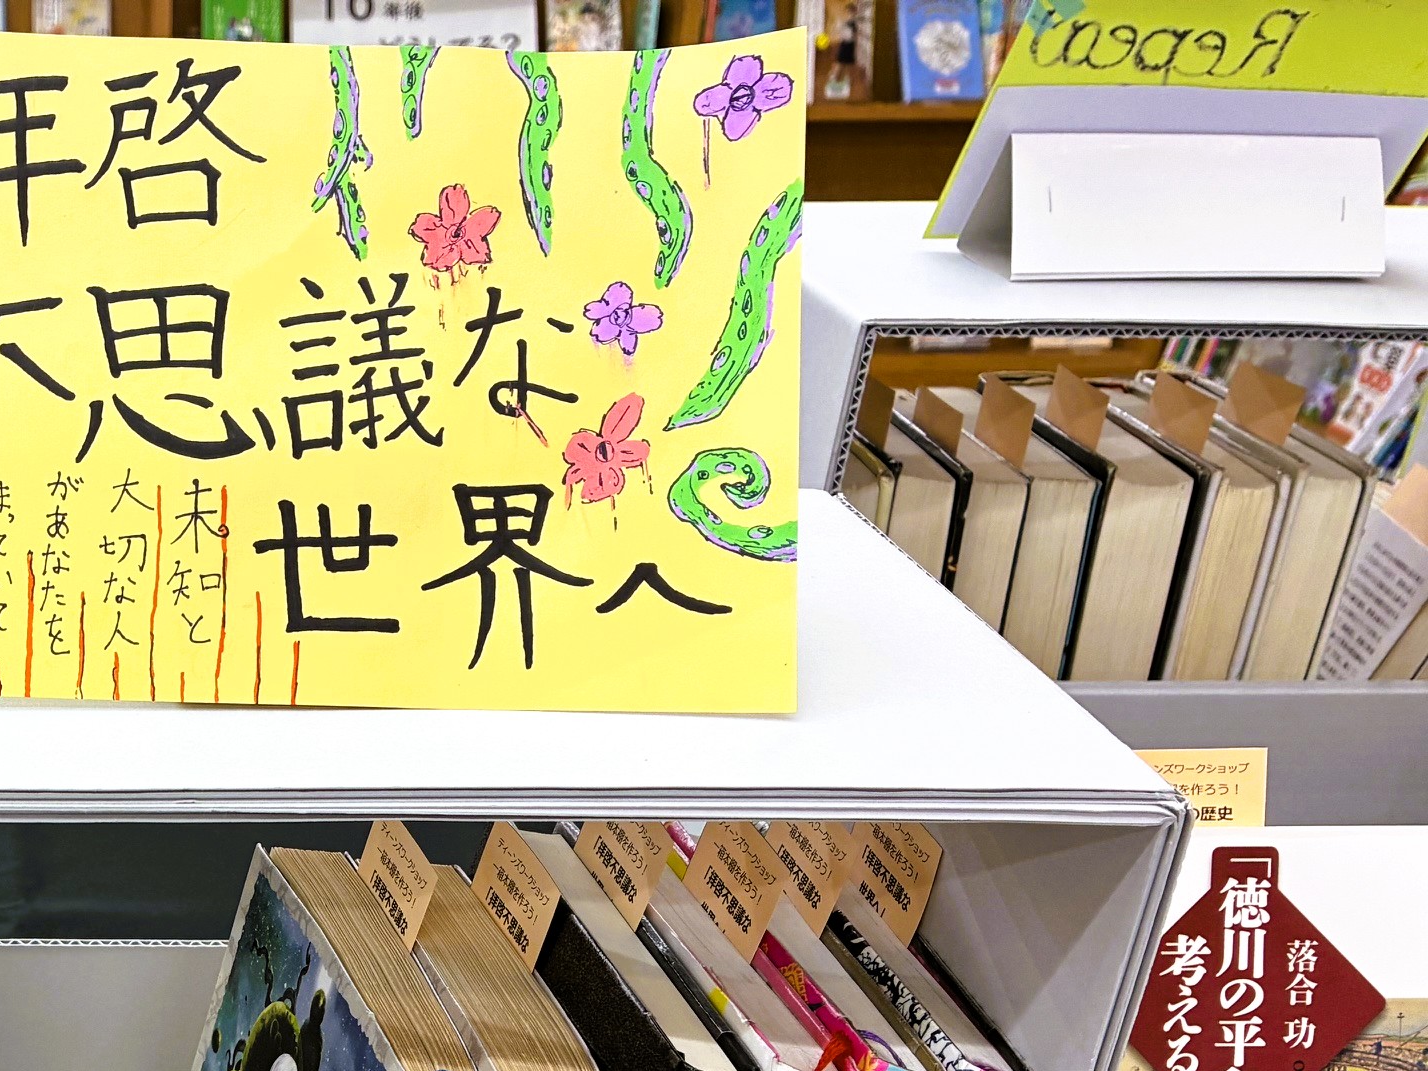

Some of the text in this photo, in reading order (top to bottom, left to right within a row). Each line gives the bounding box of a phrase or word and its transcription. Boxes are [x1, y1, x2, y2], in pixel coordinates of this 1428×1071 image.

[41, 471, 81, 656] があなたを
[100, 468, 155, 651] 大切な人
[167, 478, 225, 645] 未知と
[254, 483, 733, 670] 世界へ
[1283, 939, 1319, 1050] 落合 功
